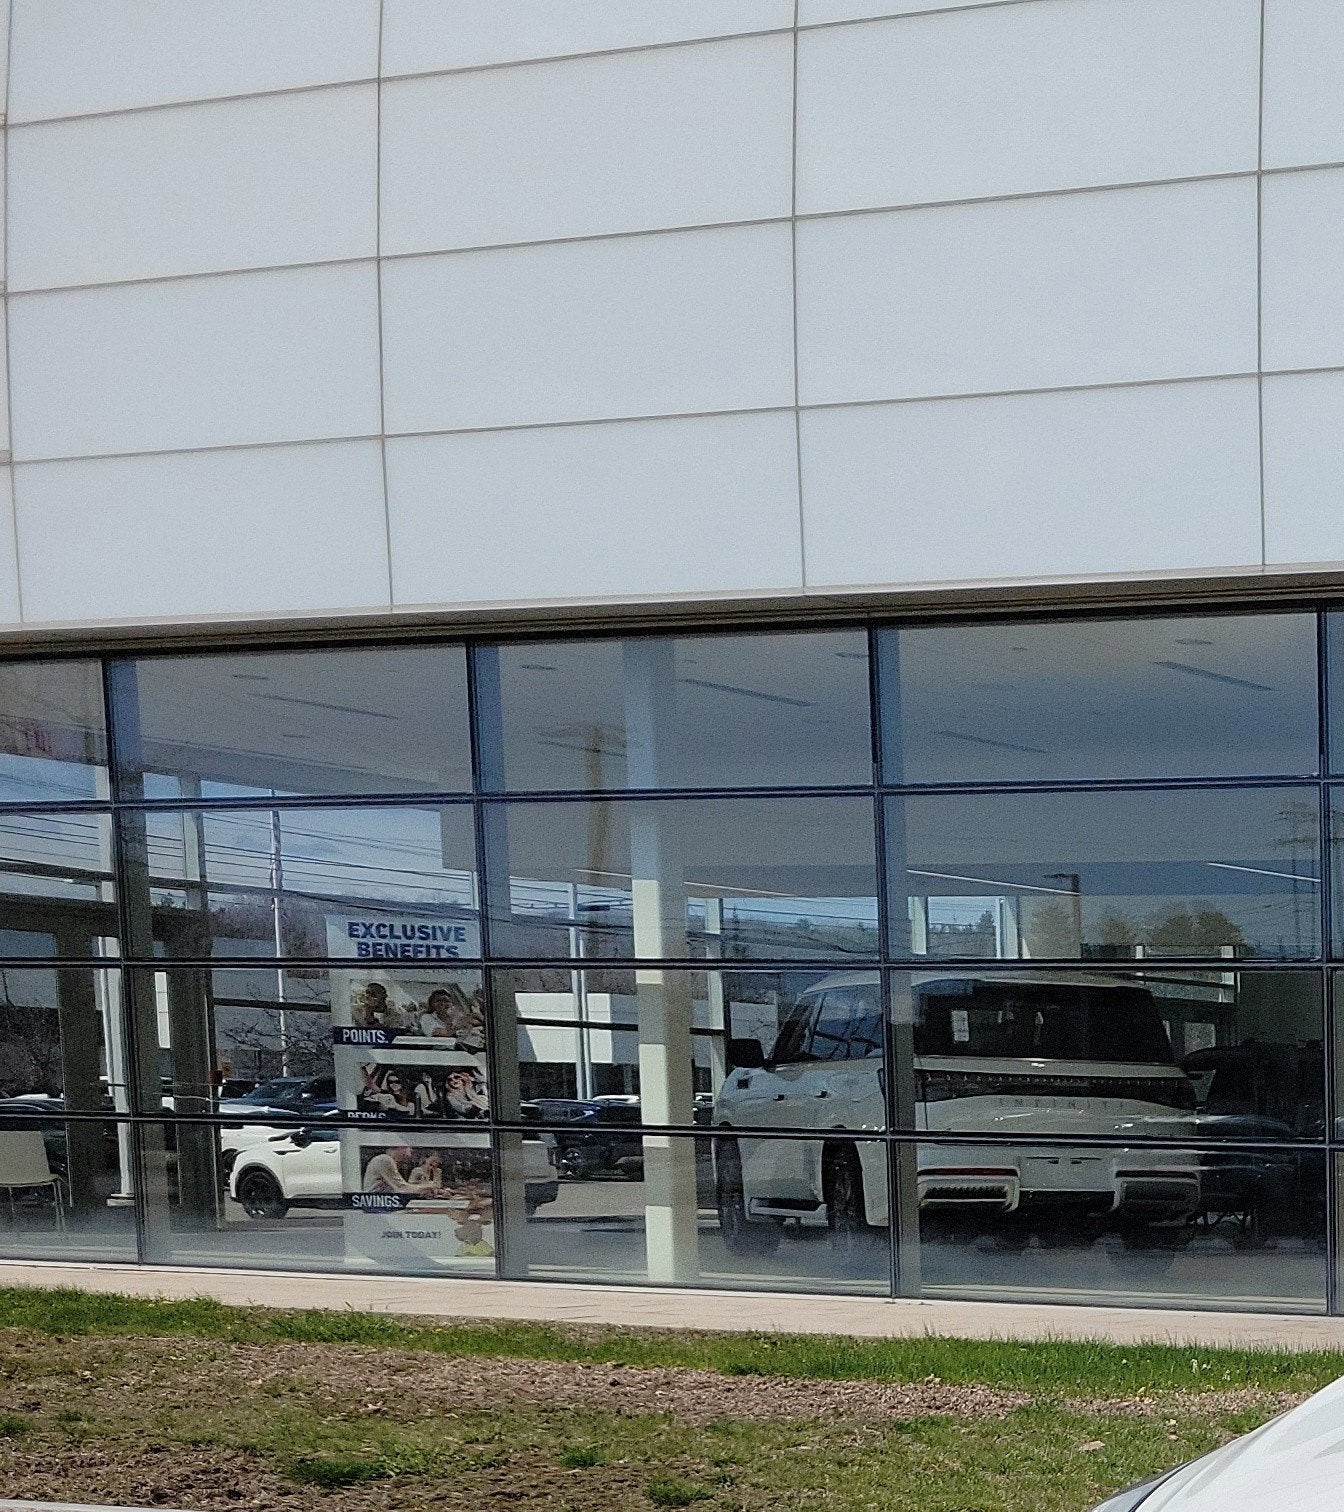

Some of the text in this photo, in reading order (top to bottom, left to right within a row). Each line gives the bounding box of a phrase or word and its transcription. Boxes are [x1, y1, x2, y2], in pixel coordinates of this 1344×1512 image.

[347, 921, 467, 943] EXCLUSIVE
[357, 941, 460, 958] BENEFITS
[381, 1230, 402, 1239] JOIN
